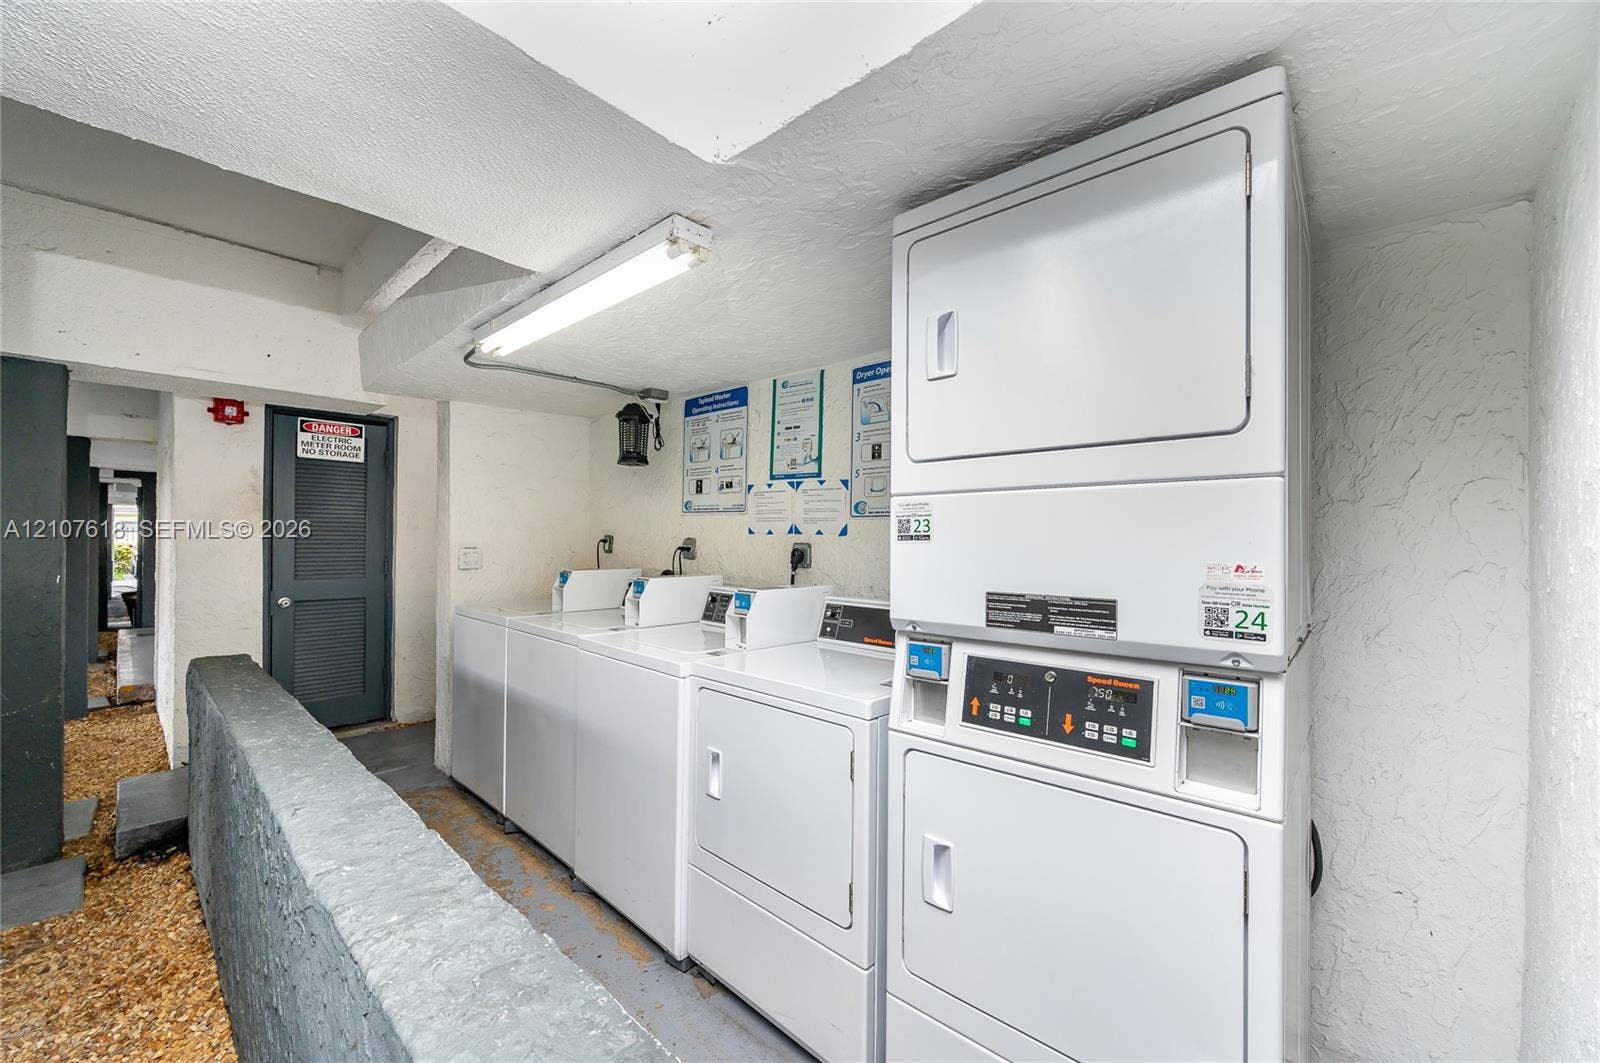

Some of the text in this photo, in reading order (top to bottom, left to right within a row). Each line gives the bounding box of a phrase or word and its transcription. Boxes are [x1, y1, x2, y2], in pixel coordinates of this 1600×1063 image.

[856, 370, 874, 379] Dryer
[311, 423, 352, 435] DANGER
[311, 434, 353, 445] ELECTRIC
[301, 440, 362, 452] METER ROOM
[302, 447, 360, 459] NO STORAGE
[913, 518, 931, 533] 23
[1234, 610, 1268, 631] 24
[1087, 675, 1141, 690] Speed Queen
